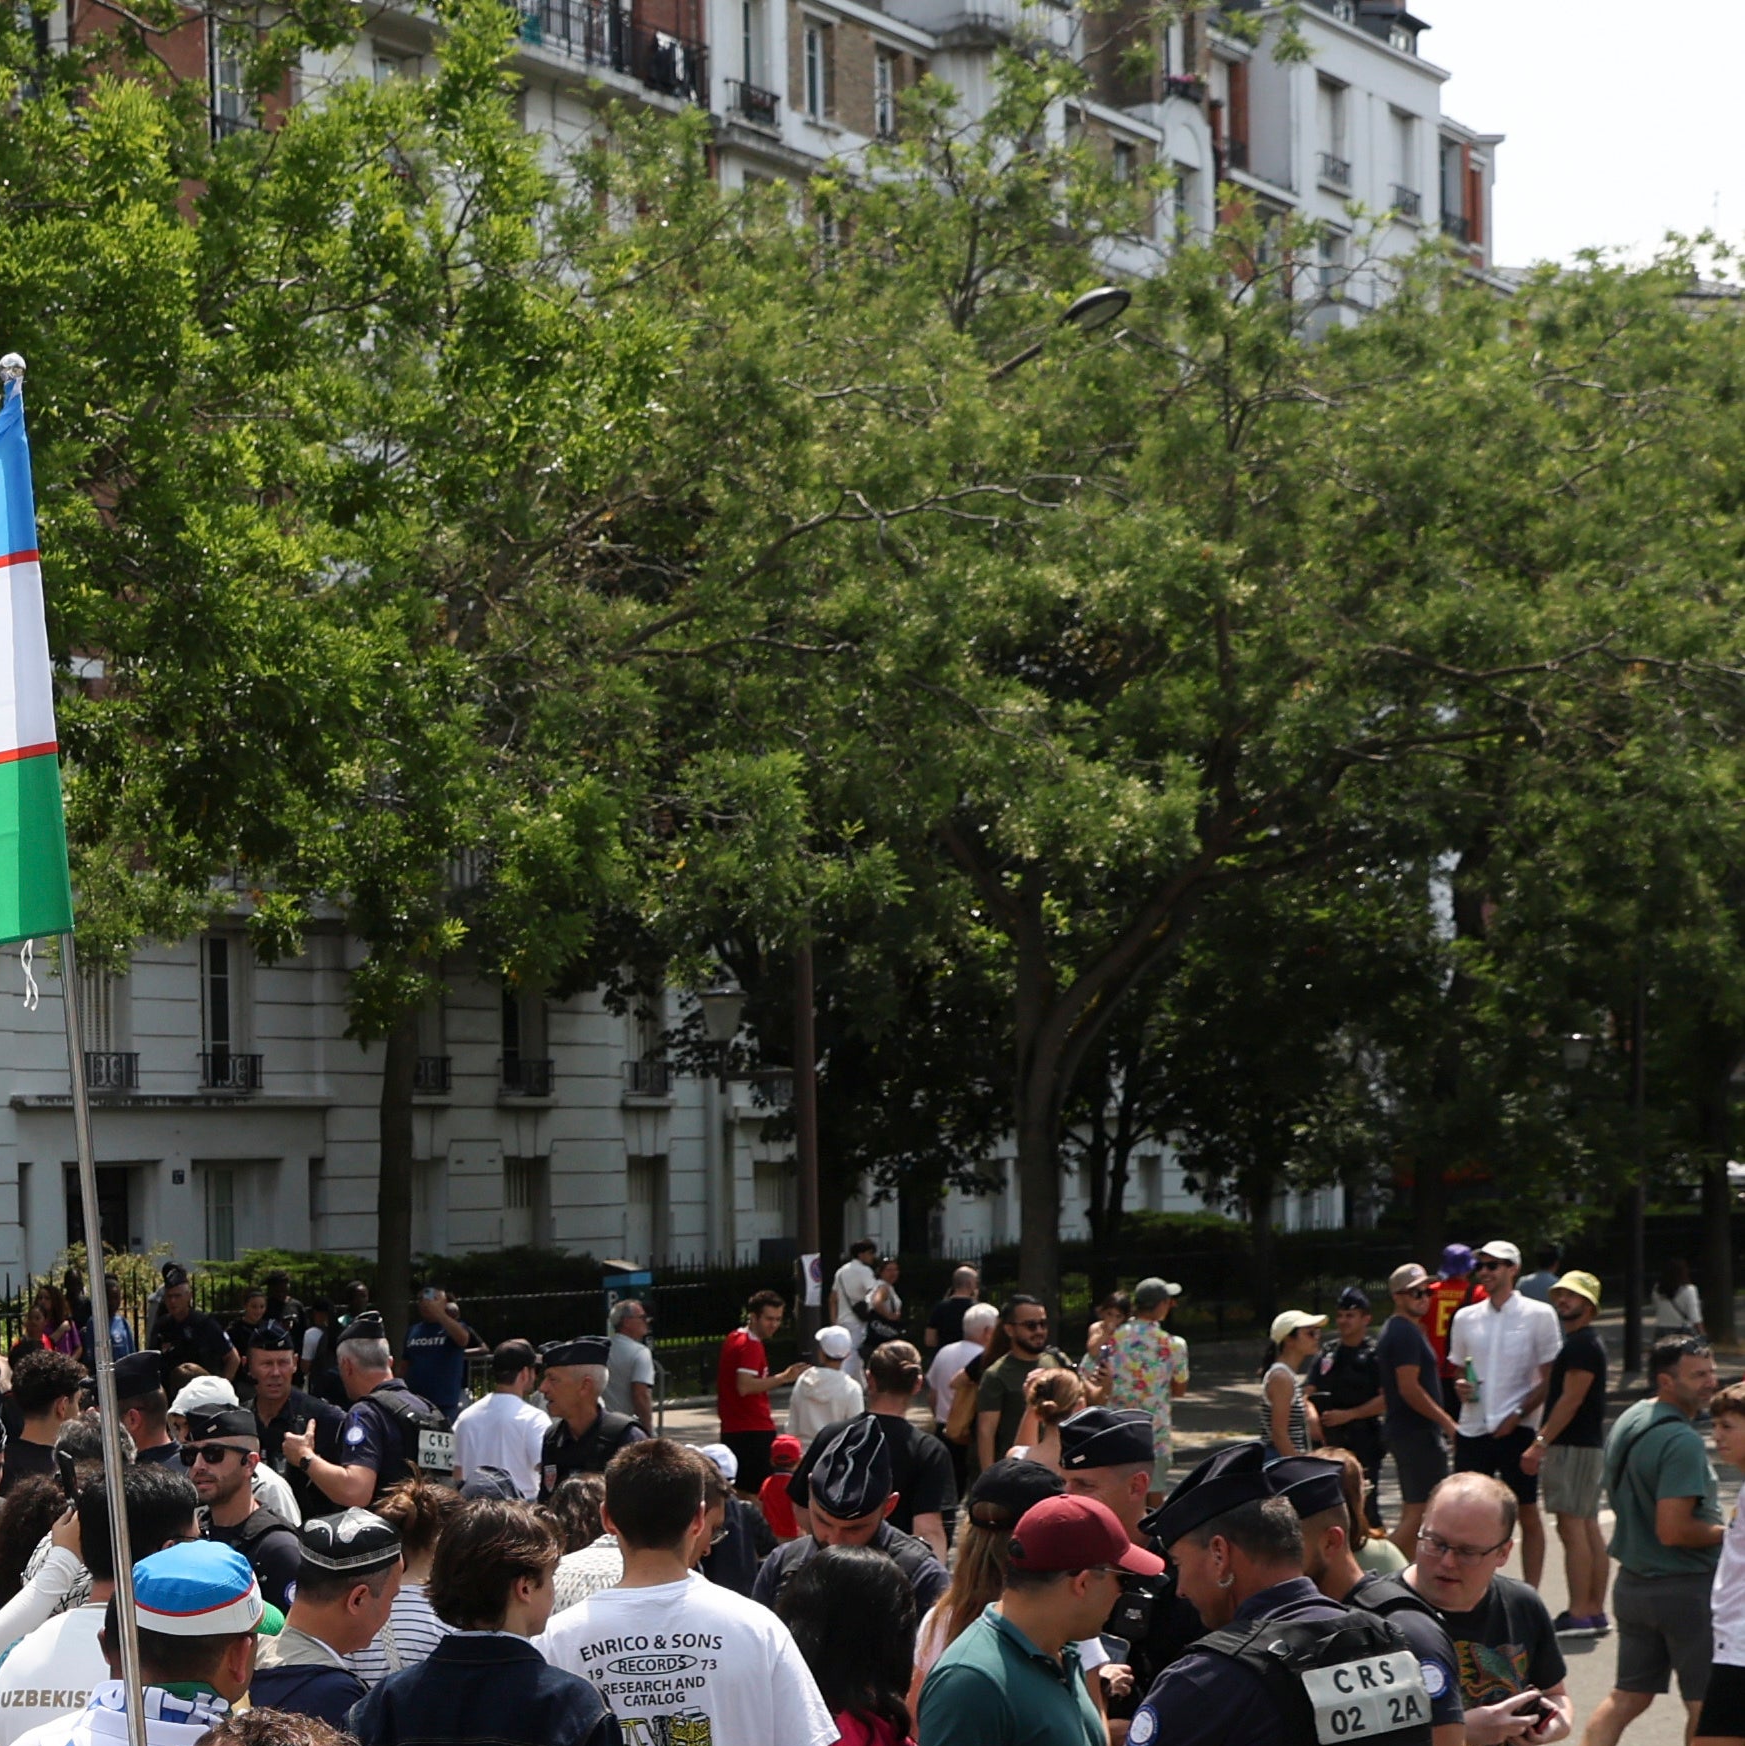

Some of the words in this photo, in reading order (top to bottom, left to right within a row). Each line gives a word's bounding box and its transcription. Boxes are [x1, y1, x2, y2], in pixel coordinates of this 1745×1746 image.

[428, 1433, 450, 1449] CRS
[424, 1452, 437, 1465] 02
[580, 1636, 648, 1662] ENRICO
[654, 1635, 666, 1650] &
[672, 1633, 722, 1650] SONS
[588, 1668, 604, 1681] 19
[617, 1656, 684, 1673] RECORDS
[701, 1658, 717, 1671] 73
[1333, 1659, 1396, 1693] CRS
[602, 1679, 670, 1695] RESEARCH
[673, 1676, 705, 1690] AND
[0, 1688, 91, 1707] UZBEKIS
[623, 1692, 684, 1707] CATALOG
[1330, 1706, 1366, 1735] 02
[1388, 1695, 1423, 1724] 2A
